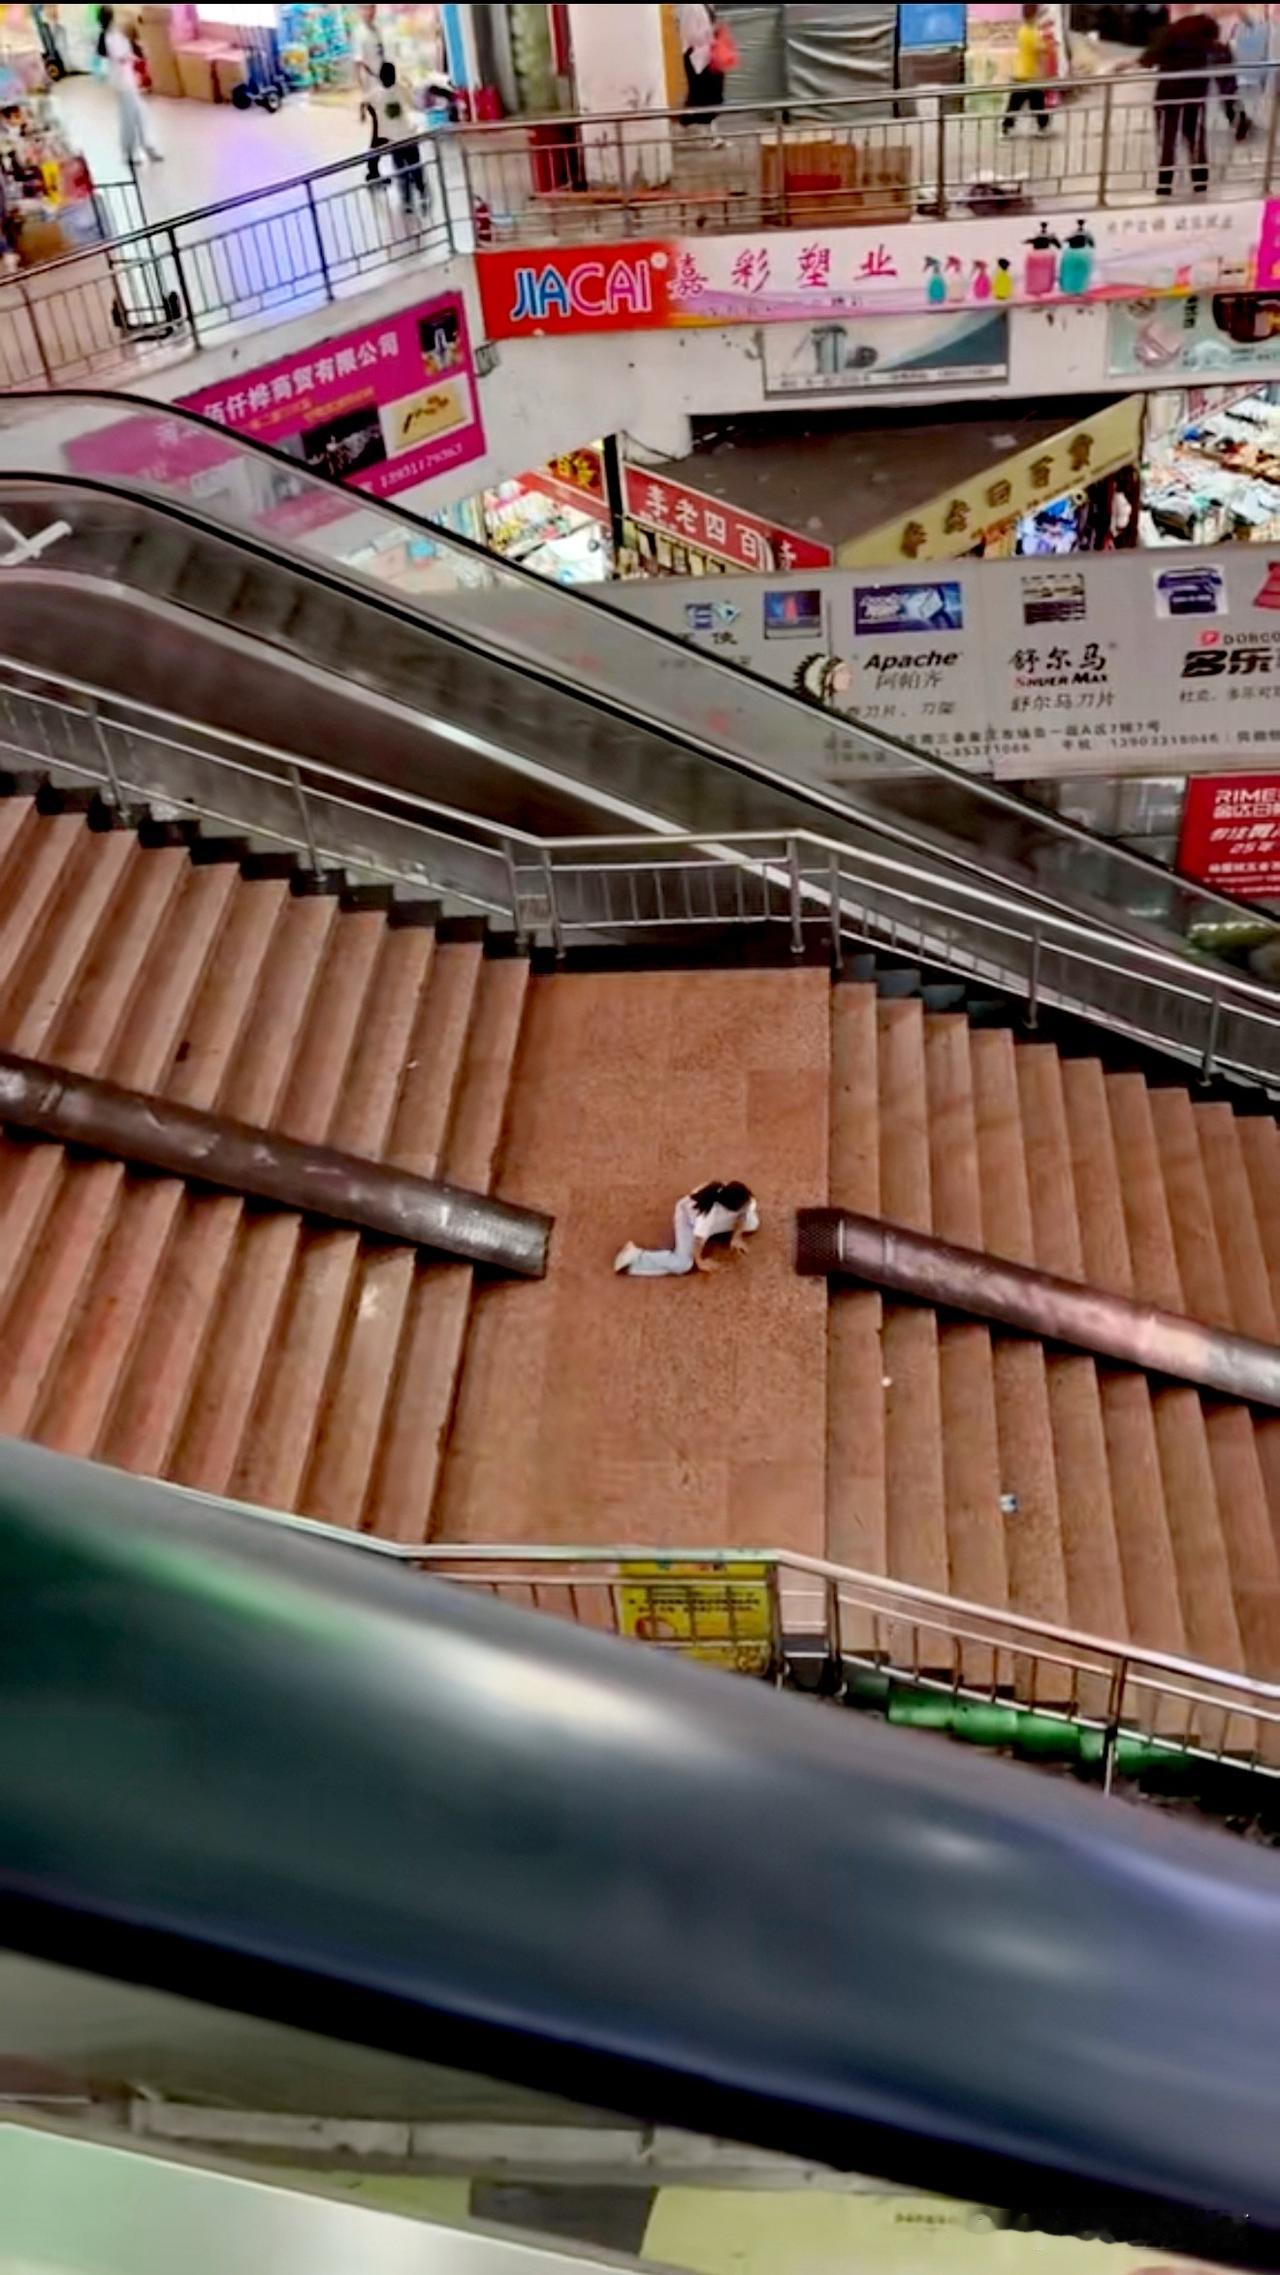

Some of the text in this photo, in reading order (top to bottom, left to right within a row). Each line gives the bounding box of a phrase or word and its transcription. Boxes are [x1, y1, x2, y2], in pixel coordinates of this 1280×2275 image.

[666, 243, 898, 296] 嘉彩塑业
[510, 259, 652, 322] JIACAI
[863, 650, 959, 673] Apache
[1009, 642, 1107, 674] 舒尔马
[1180, 647, 1280, 678] 多乐
[1214, 787, 1280, 804] RIME
